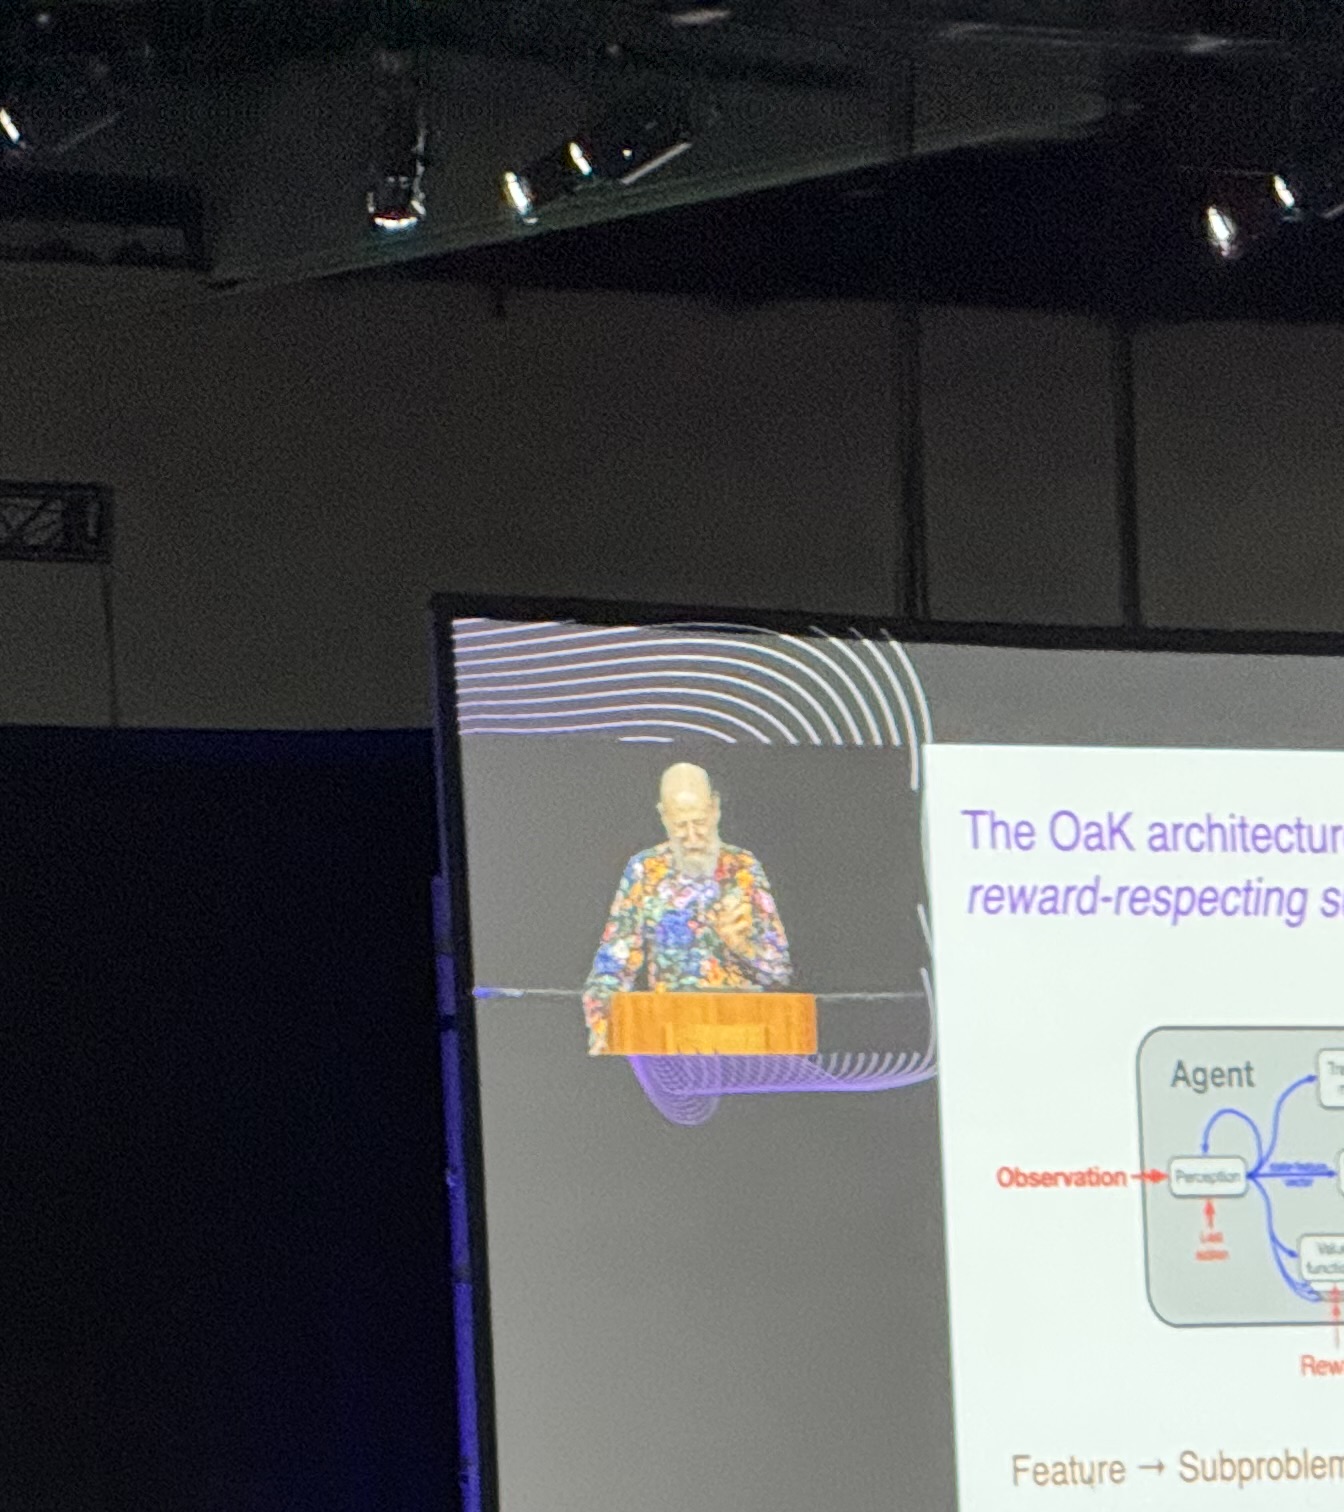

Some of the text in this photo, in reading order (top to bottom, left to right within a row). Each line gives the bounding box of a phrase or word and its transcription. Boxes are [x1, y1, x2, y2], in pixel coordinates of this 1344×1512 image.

[961, 809, 1036, 851] The
[1050, 809, 1135, 852] OaK
[968, 875, 1308, 928] reward-respecting
[1170, 1060, 1255, 1094] Agent
[996, 1167, 1127, 1187] Observation
[1011, 1454, 1126, 1487] Feature
